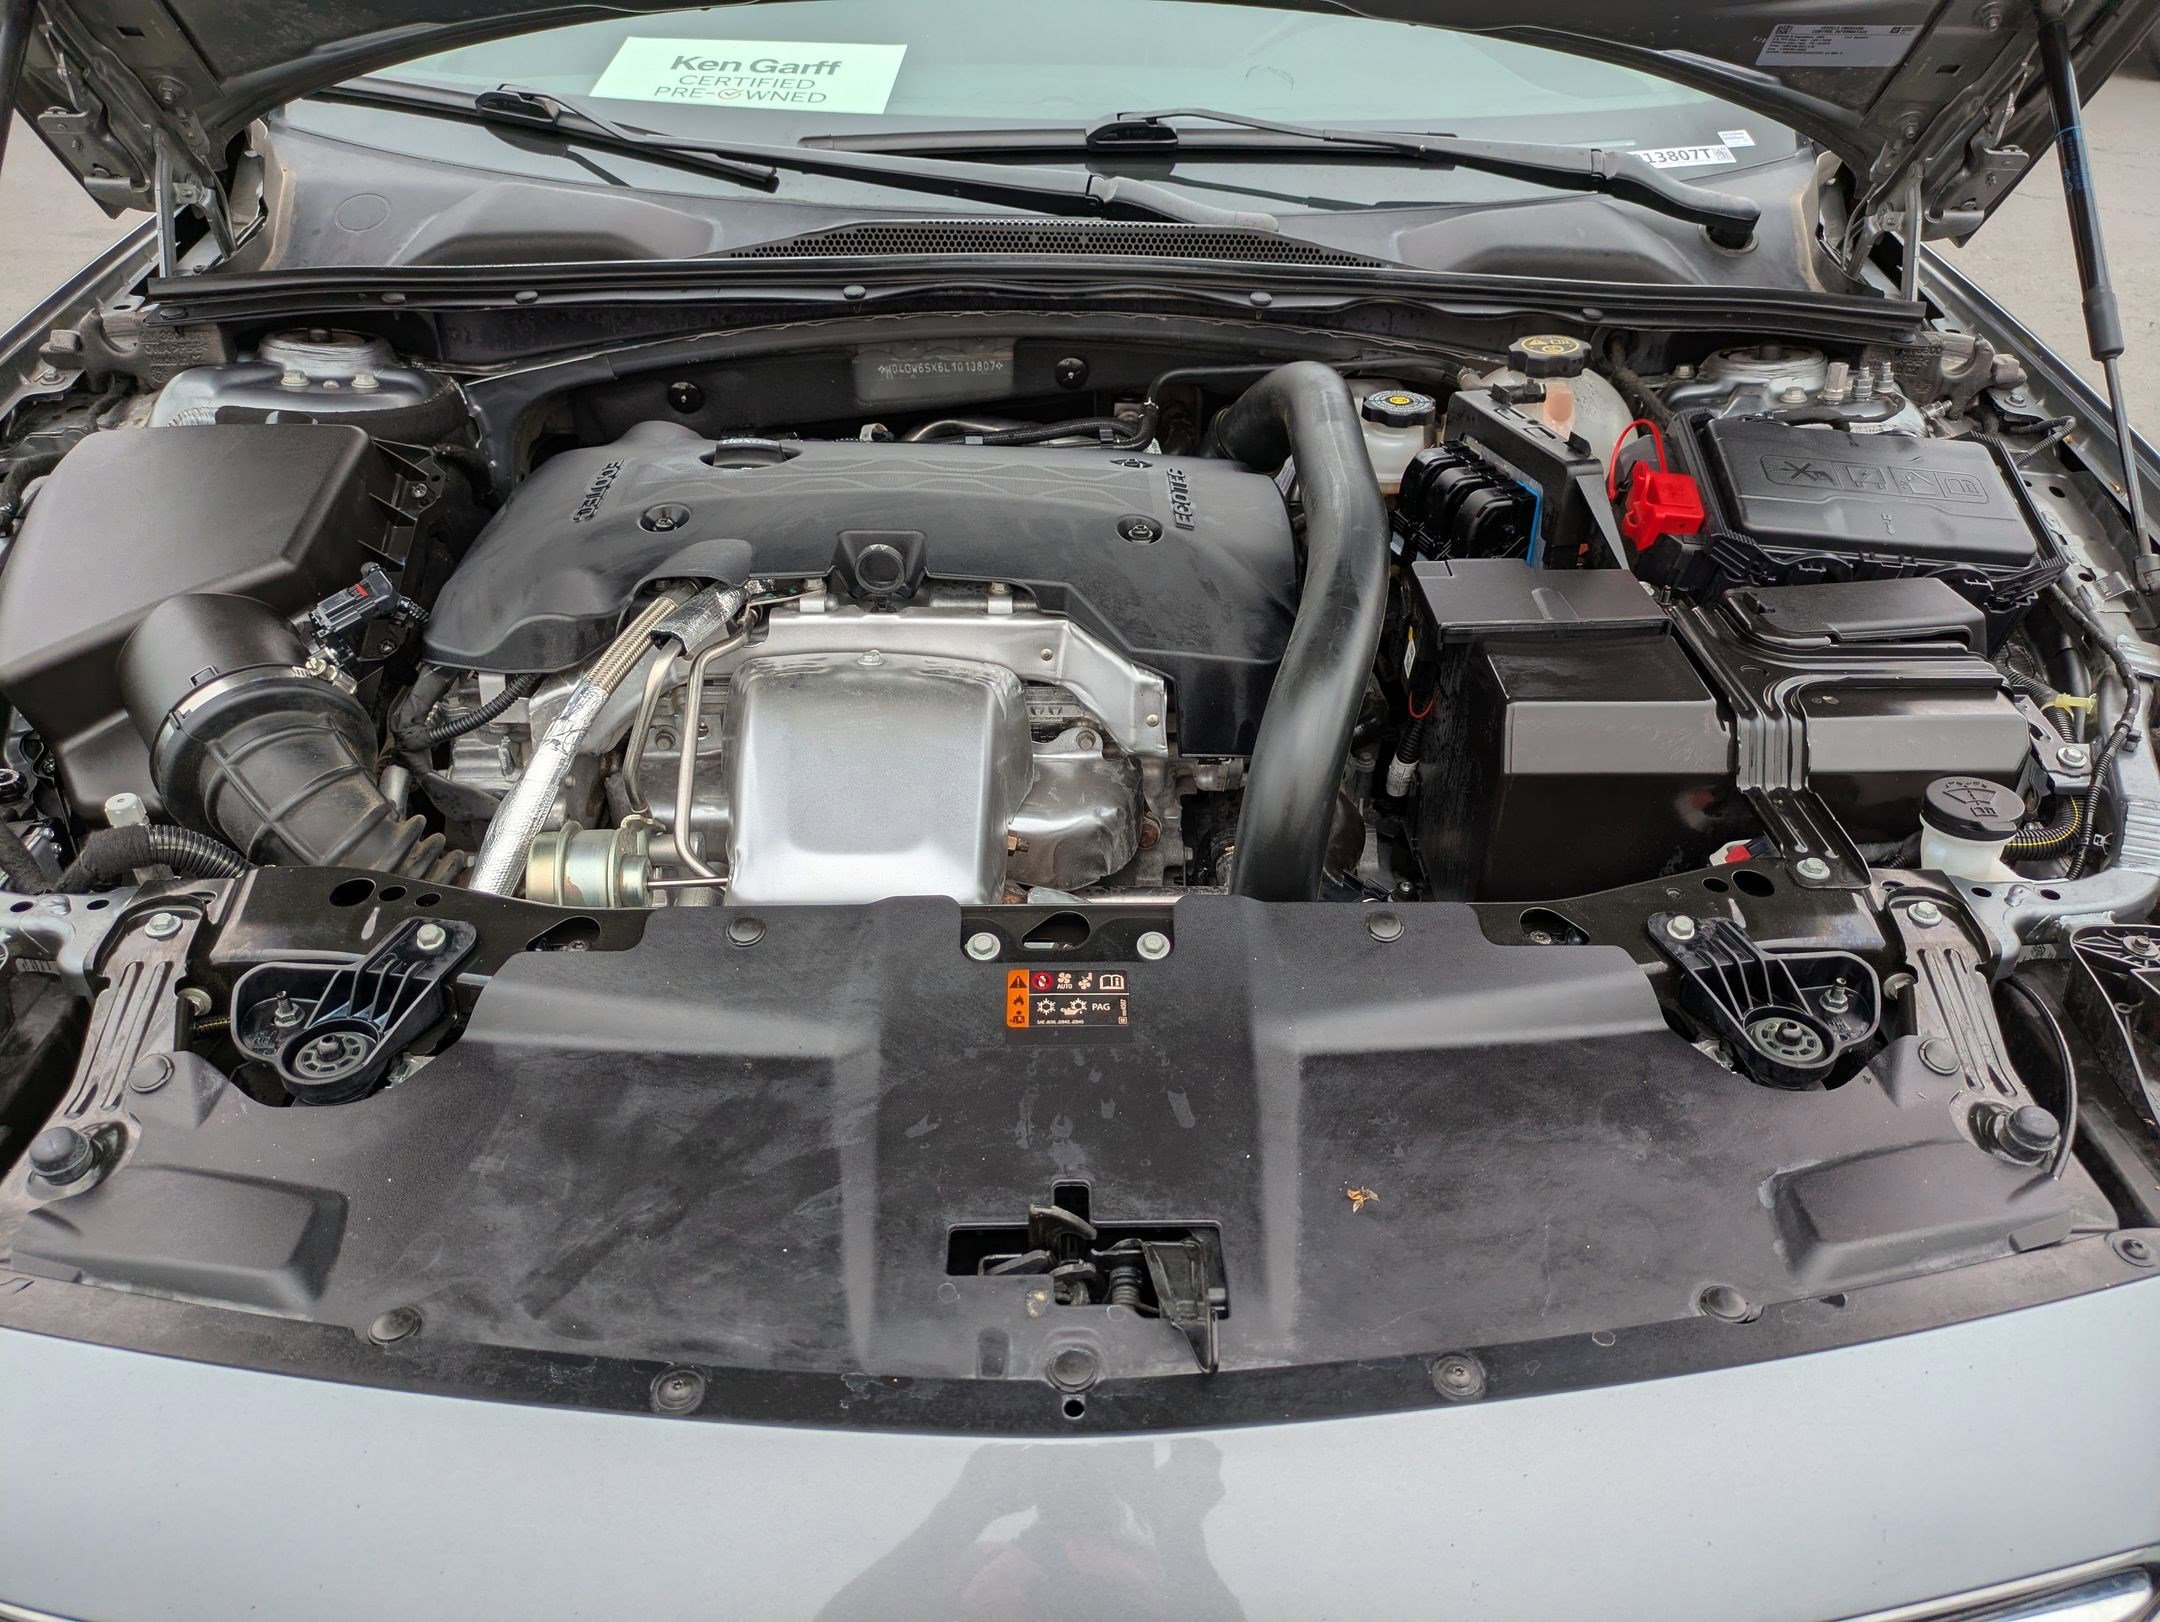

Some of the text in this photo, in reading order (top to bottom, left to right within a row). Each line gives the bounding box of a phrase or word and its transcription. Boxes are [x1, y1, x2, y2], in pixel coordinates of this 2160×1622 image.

[670, 55, 842, 76] Ken Garff
[679, 75, 816, 90] CERTIFIED
[653, 86, 827, 103] PRE-OWNED
[1643, 148, 1711, 164] 13807T
[572, 459, 625, 523] ECOTEC
[1166, 467, 1196, 531] ECOTEC
[1091, 1003, 1111, 1011] PAG
